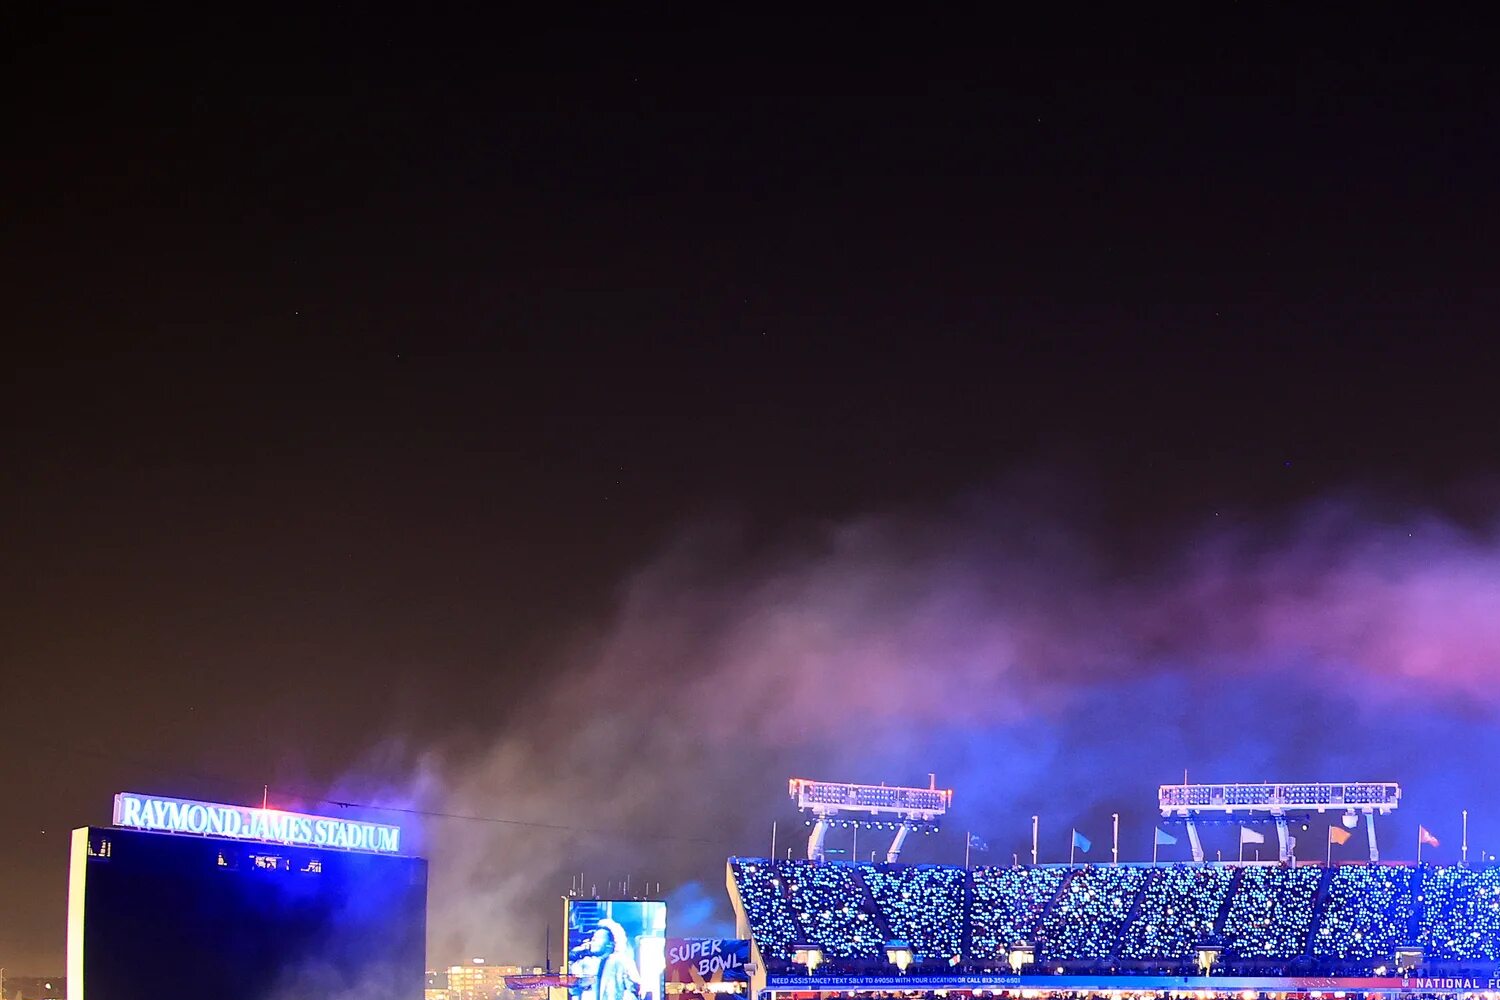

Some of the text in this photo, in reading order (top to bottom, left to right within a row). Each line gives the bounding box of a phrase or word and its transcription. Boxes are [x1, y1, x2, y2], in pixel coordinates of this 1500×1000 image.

[121, 797, 400, 851] RAYMOND JAMES STADIUM
[669, 940, 722, 964] SUPER
[698, 953, 742, 976] BOWL
[1416, 978, 1480, 989] NATIONAL
